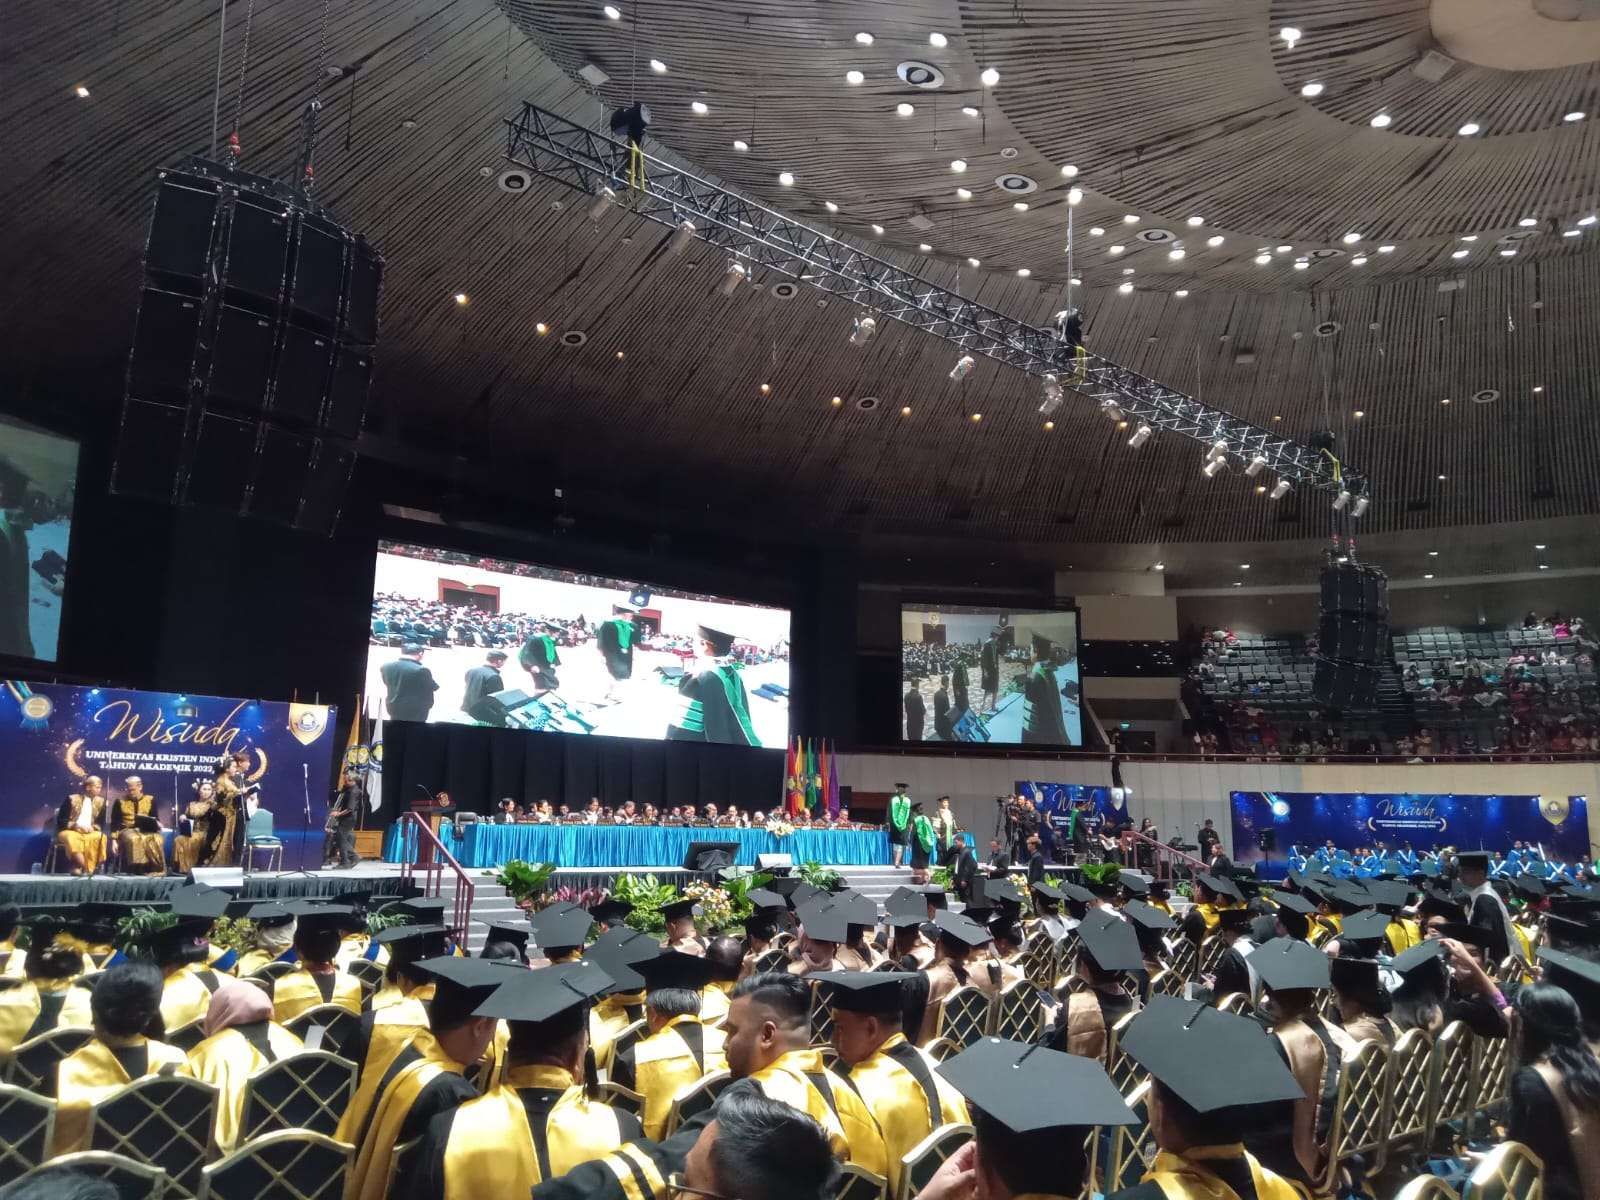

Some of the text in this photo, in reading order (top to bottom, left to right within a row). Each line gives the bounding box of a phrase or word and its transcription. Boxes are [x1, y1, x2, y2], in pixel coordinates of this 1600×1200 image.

[94, 700, 248, 755] Wisuda
[86, 750, 153, 761] UNIVERSITAS
[156, 753, 197, 762] KRISTEN
[99, 761, 136, 770] TAHUN
[138, 763, 191, 772] AKADEMIK
[1376, 797, 1437, 820] Wisuda
